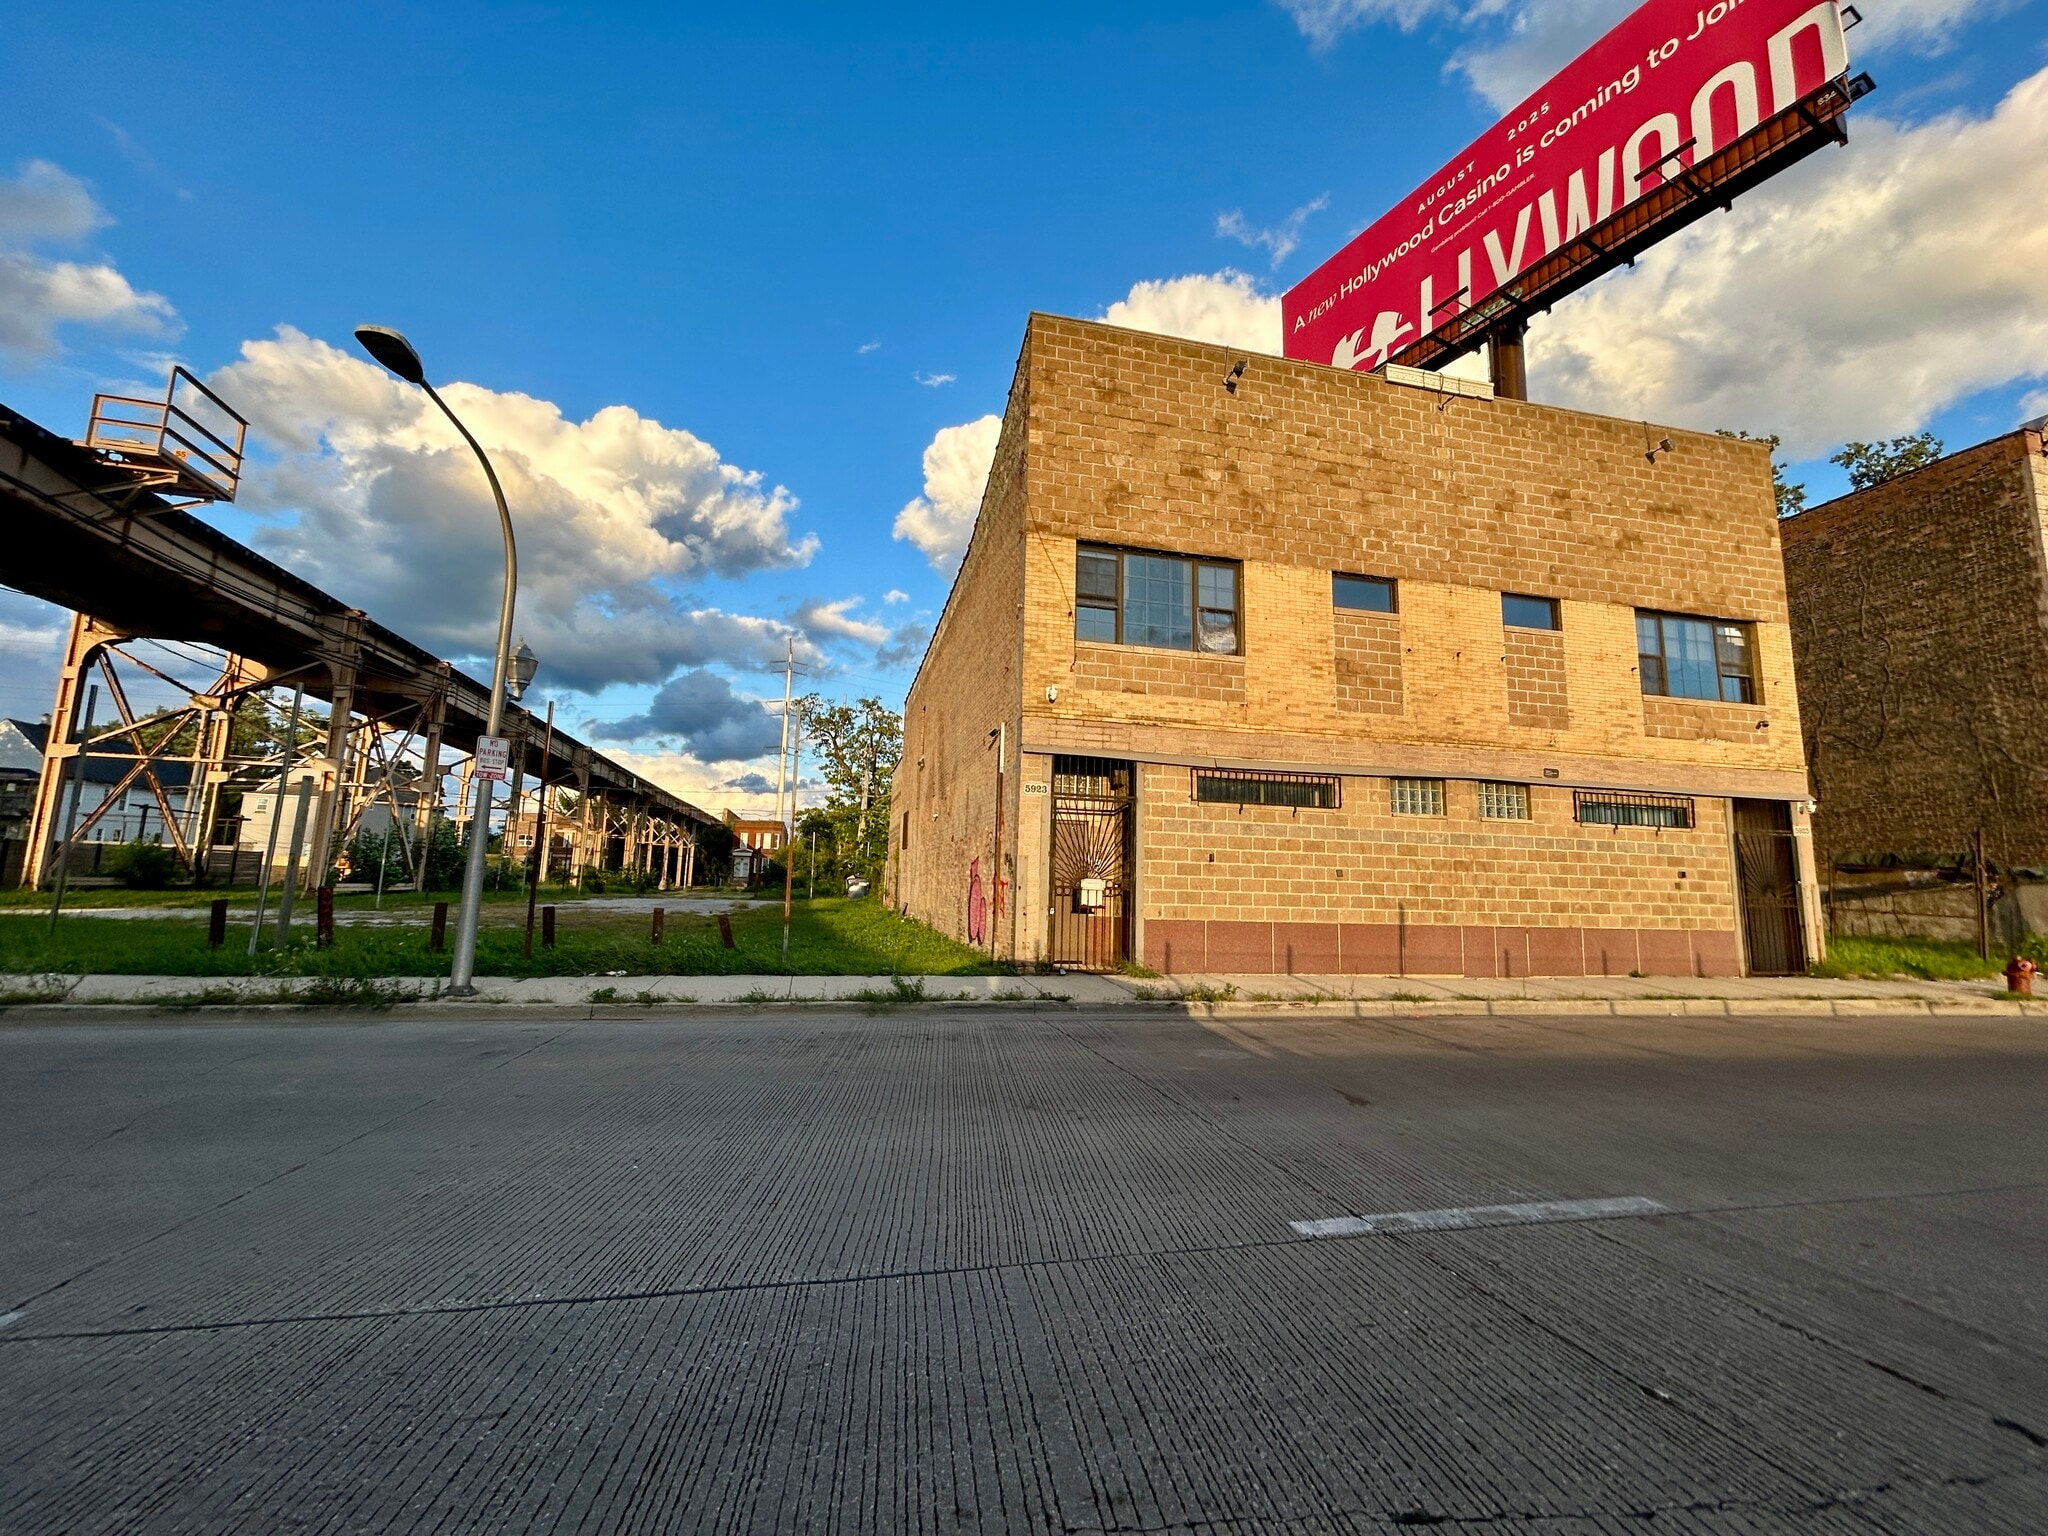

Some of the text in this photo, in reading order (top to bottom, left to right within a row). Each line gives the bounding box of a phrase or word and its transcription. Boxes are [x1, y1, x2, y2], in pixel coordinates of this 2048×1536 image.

[1417, 102, 1549, 214] AUGUST 2025
[1294, 315, 1305, 334] A
[1308, 292, 1337, 323] new
[1340, 217, 1434, 299] Hollywood
[1438, 164, 1511, 226] Casino
[1516, 144, 1535, 168] is
[1540, 64, 1640, 148] coming
[1646, 37, 1680, 69] to
[1430, 233, 1454, 253] Gambling
[1477, 208, 1488, 218] Call
[480, 748, 507, 758] PARKING
[1025, 784, 1048, 793] 5923
